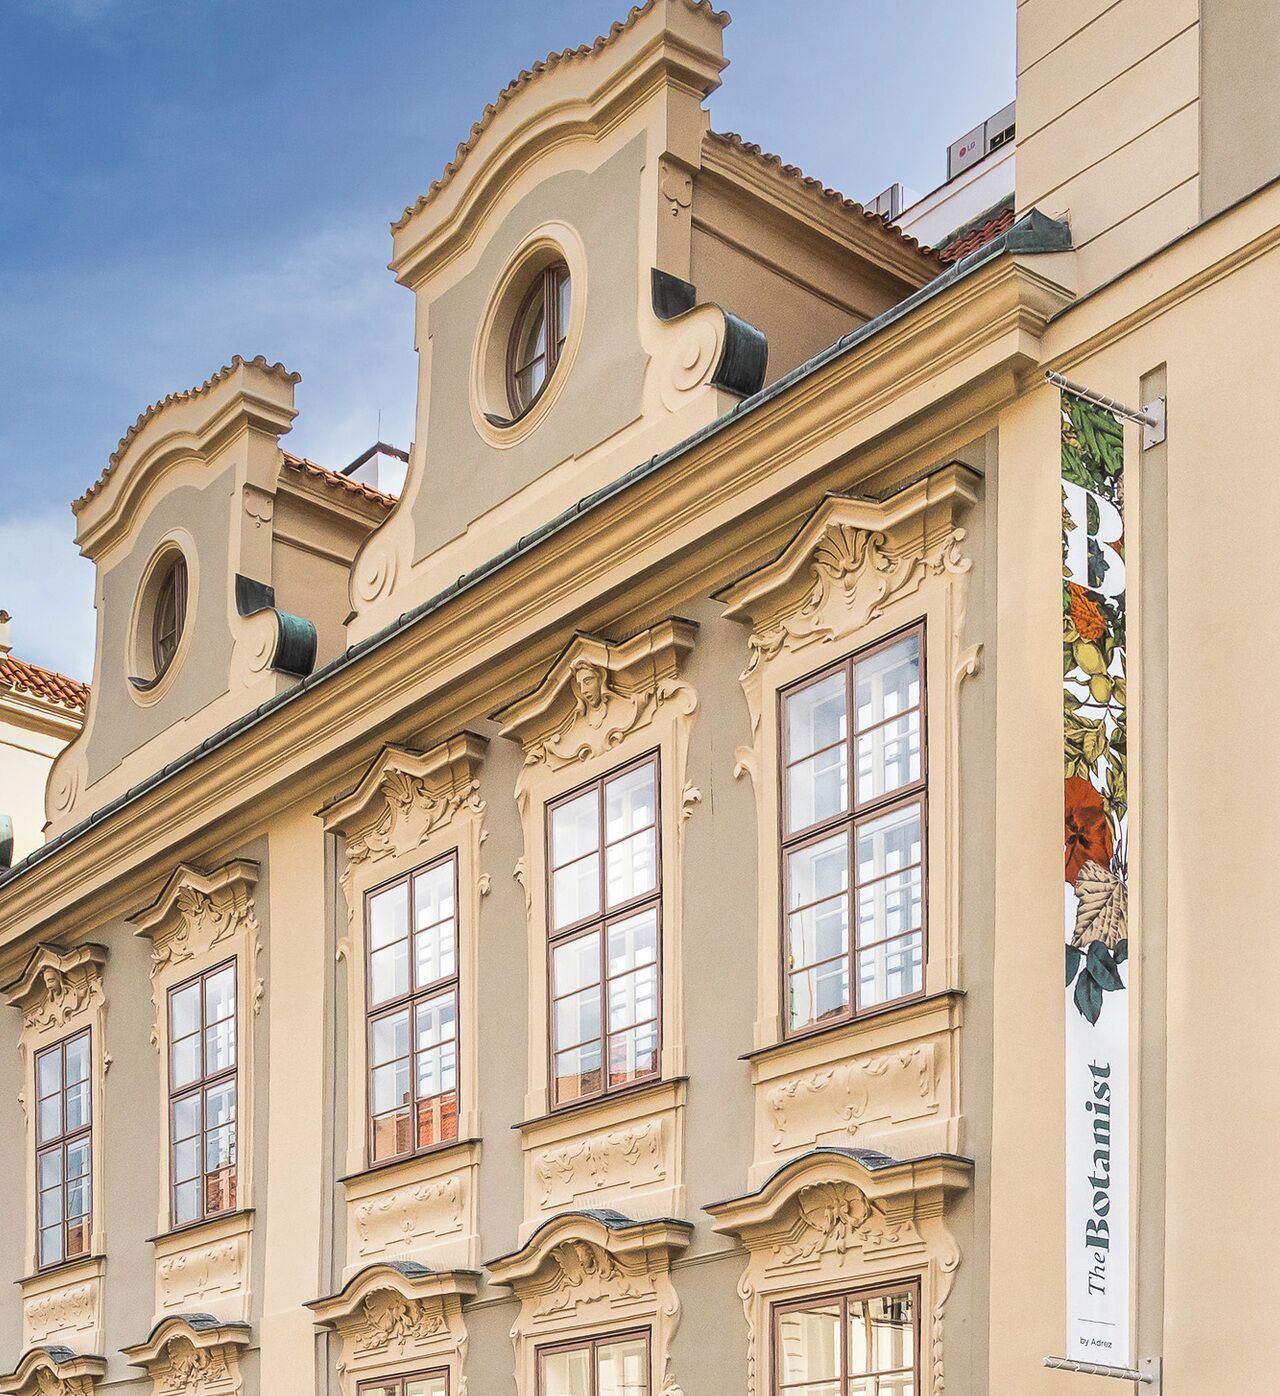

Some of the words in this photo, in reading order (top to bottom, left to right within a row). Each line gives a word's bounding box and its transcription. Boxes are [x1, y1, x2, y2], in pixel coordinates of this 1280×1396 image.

[1085, 1059, 1112, 1252] Botanist
[1088, 1252, 1106, 1296] The
[1080, 1336, 1089, 1346] by
[1091, 1338, 1112, 1348] Adrez
